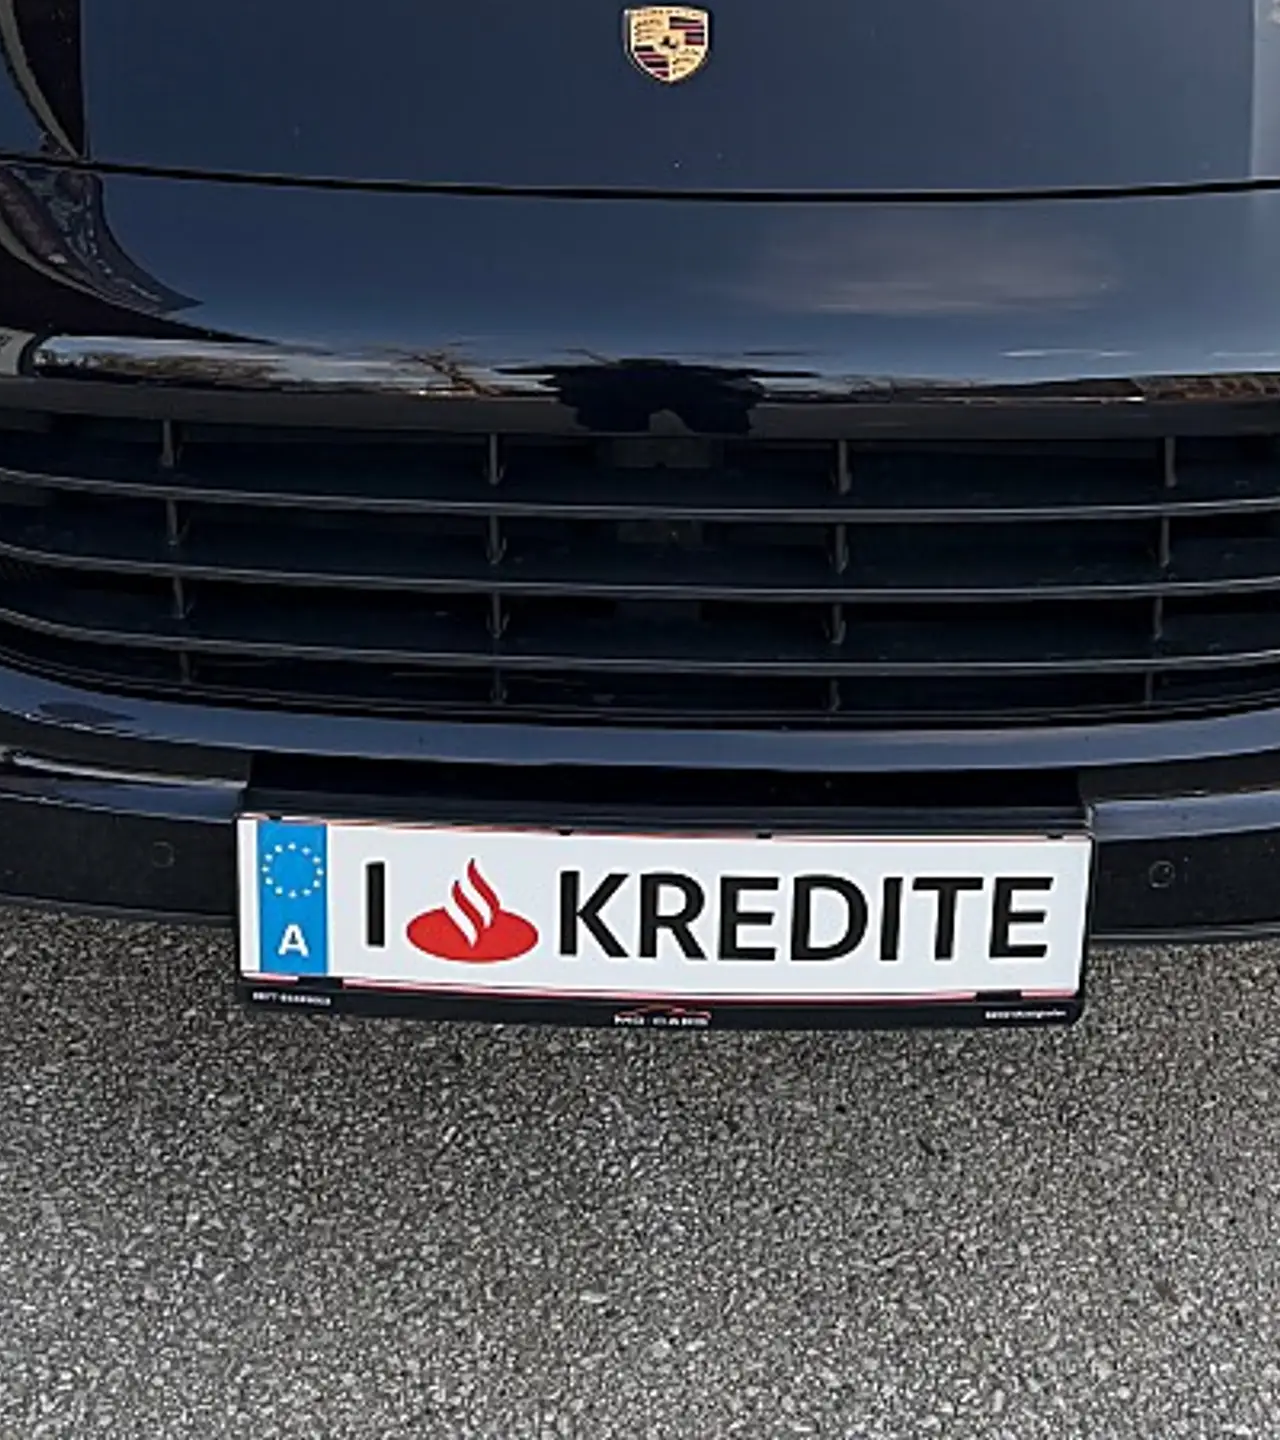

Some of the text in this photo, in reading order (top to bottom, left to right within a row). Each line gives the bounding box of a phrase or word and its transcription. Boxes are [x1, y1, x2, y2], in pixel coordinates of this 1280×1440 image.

[278, 923, 310, 958] A
[365, 861, 1054, 962] I KREDITE
